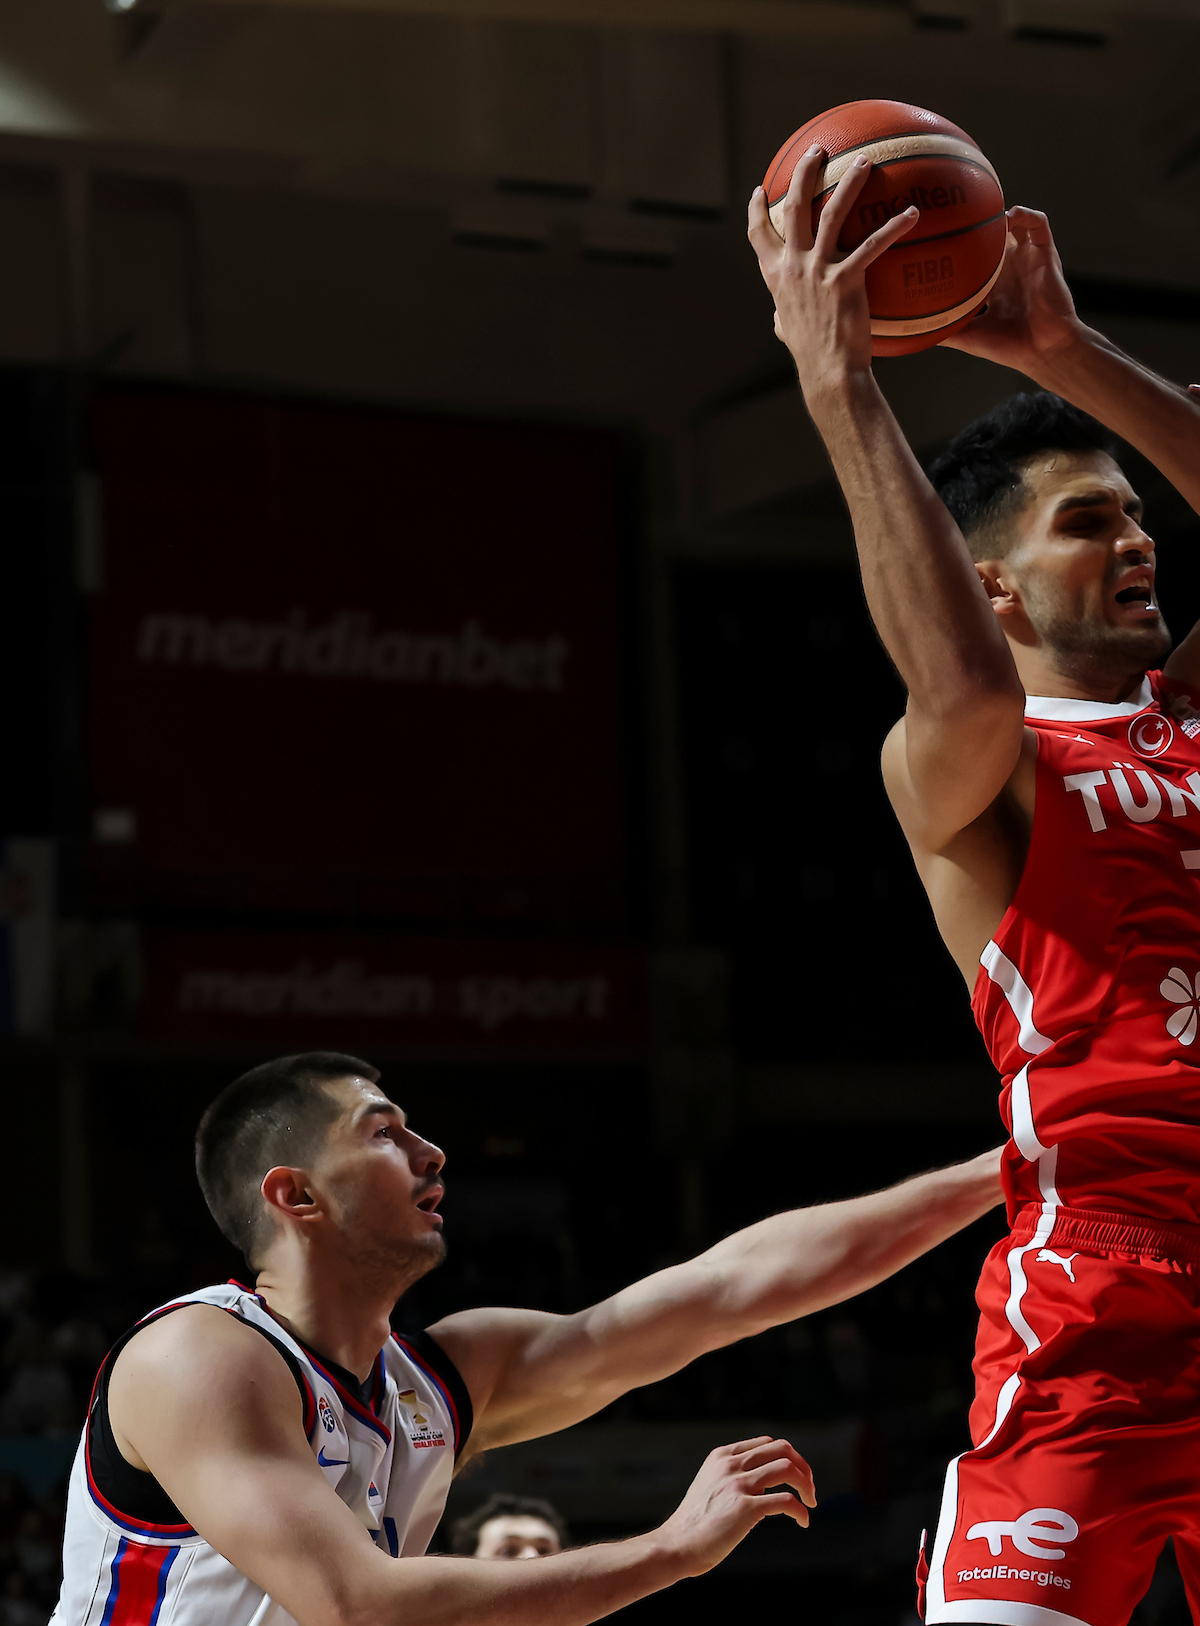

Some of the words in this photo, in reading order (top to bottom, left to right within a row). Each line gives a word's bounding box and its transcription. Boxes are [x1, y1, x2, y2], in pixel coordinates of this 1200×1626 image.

[902, 255, 954, 287] FIBA
[138, 605, 571, 693] meridianbet
[178, 958, 433, 1018] meridian
[460, 973, 609, 1034] sport
[957, 1565, 1072, 1590] TotalEnergies
